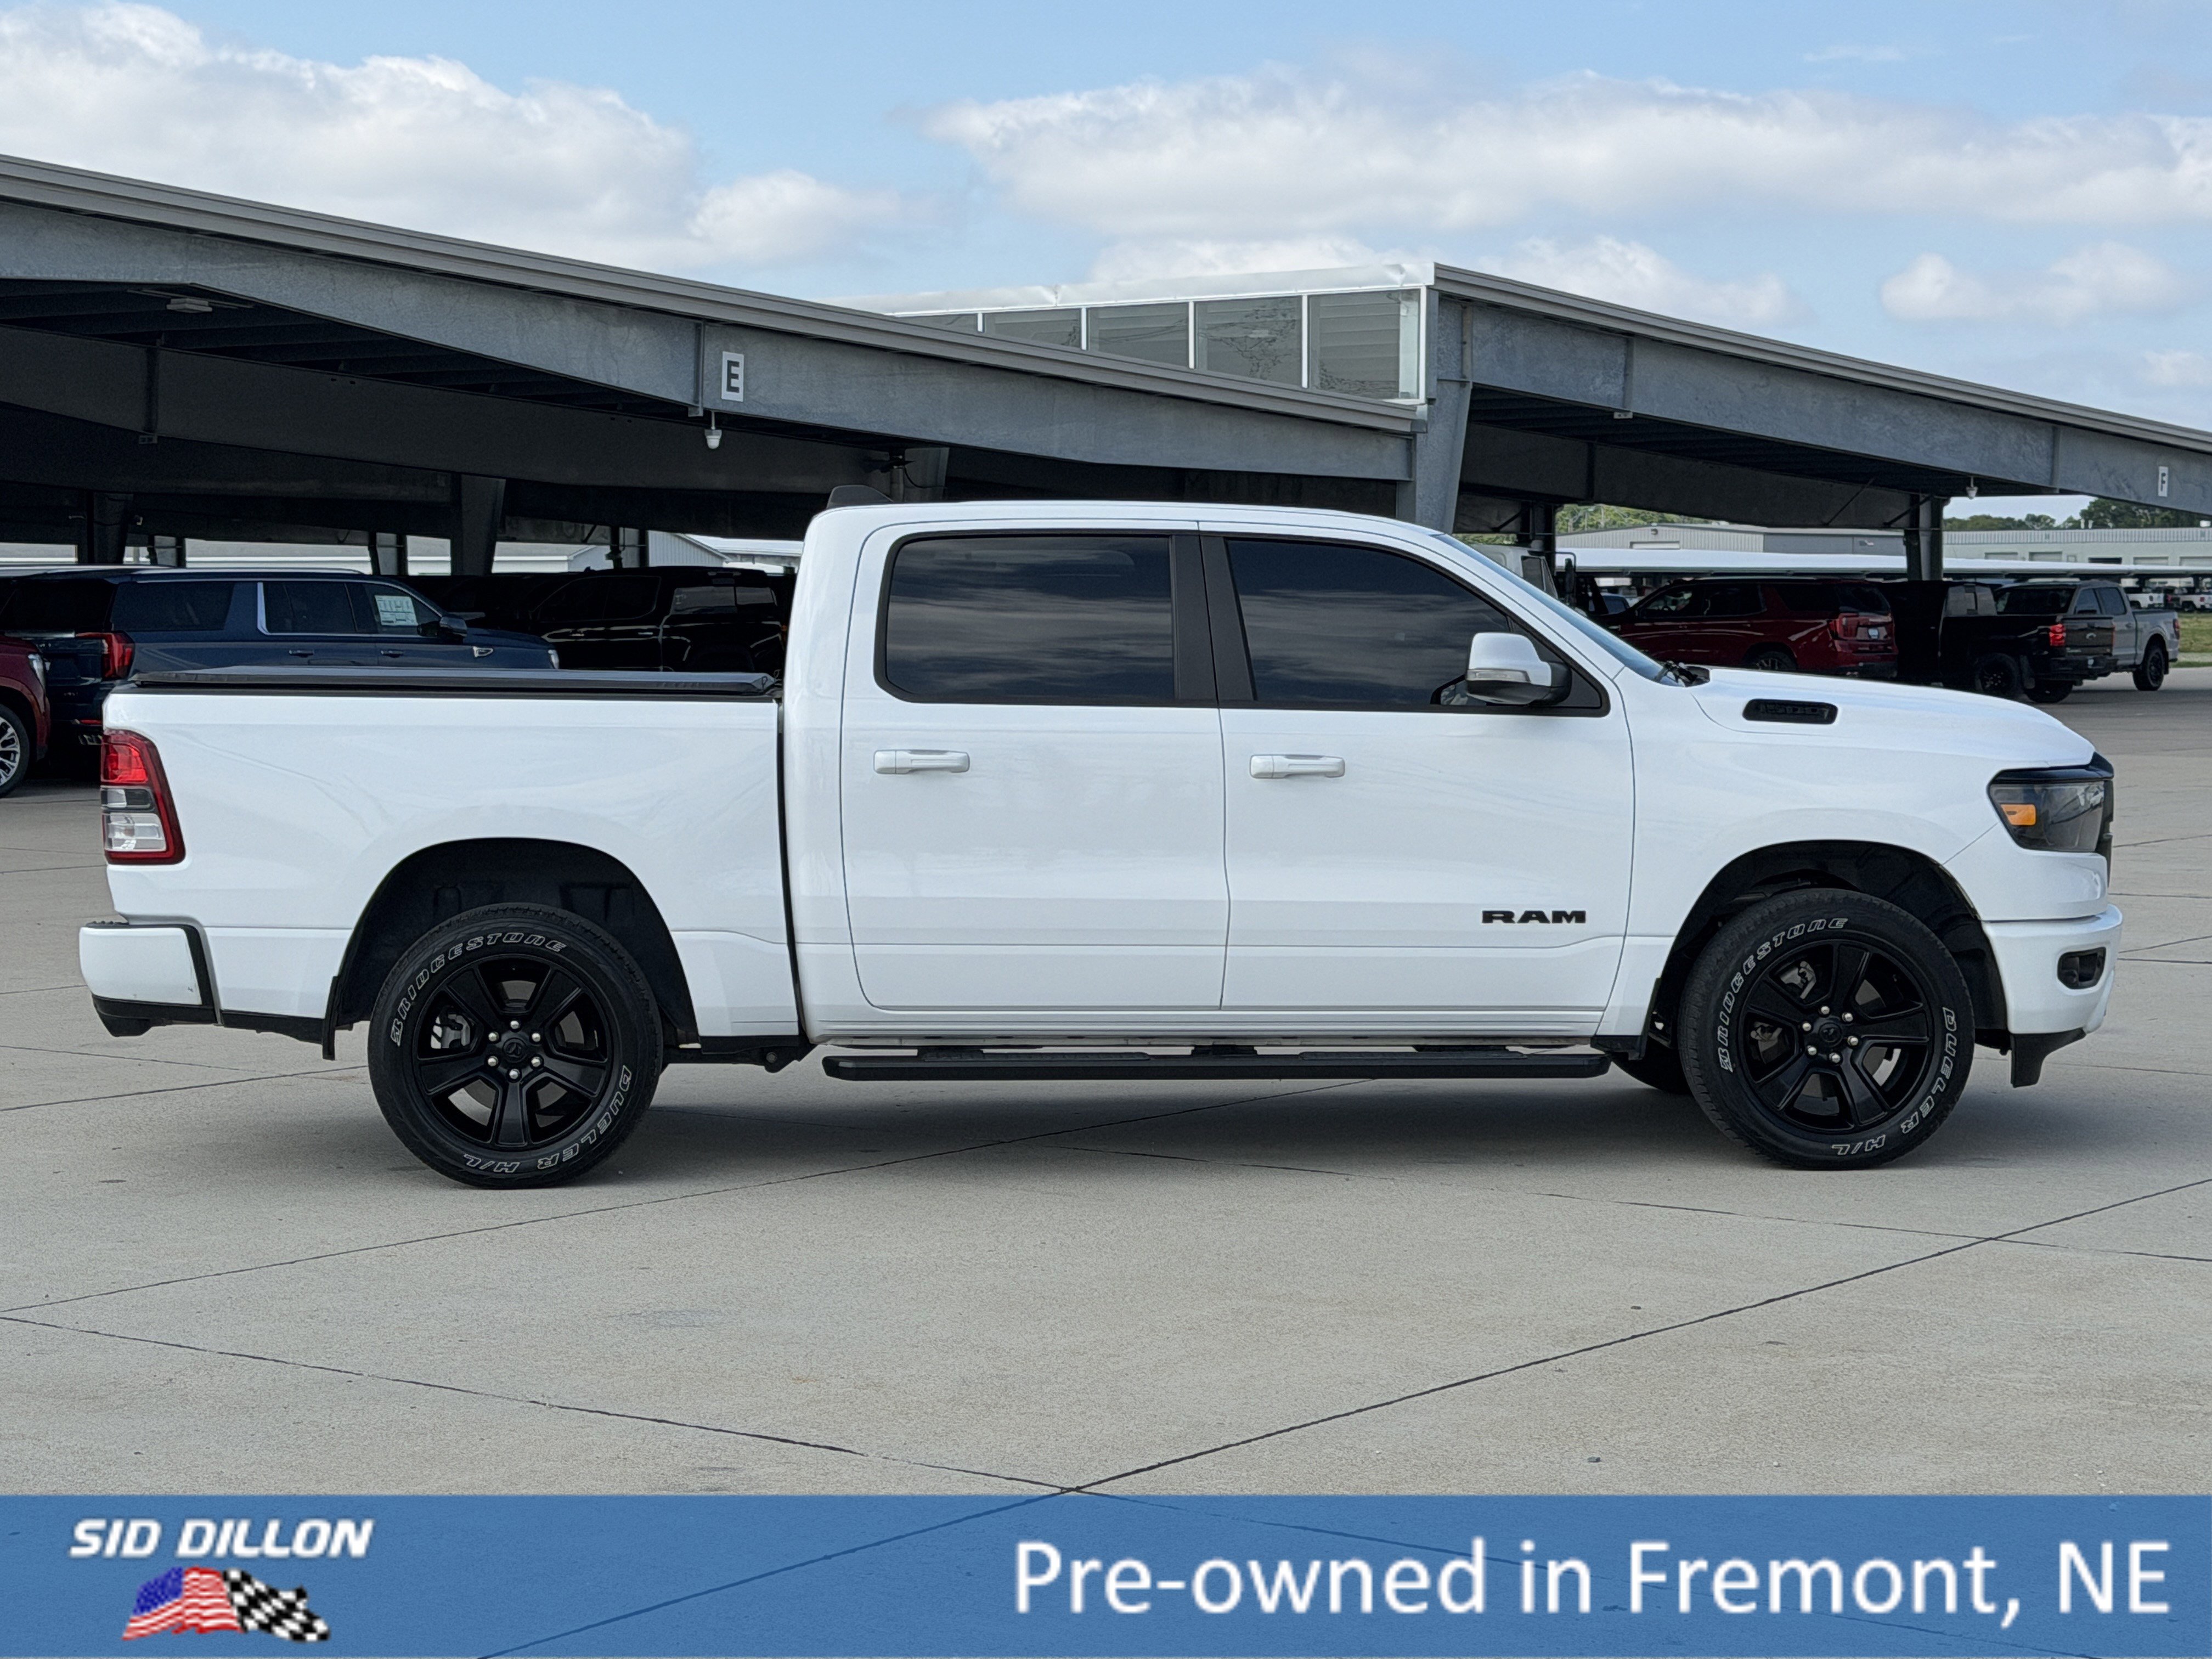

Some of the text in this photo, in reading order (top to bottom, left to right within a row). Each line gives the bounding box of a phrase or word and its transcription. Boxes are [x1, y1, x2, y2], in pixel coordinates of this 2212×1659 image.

[726, 359, 740, 393] E
[2160, 472, 2166, 492] F
[1482, 910, 1586, 924] RAM
[390, 932, 567, 1047] BRIDGESTONE
[1716, 918, 1848, 1073] BRIDGESTONE
[462, 1065, 633, 1173] DUELER H/L
[1831, 1007, 1958, 1156] DUELER H/L
